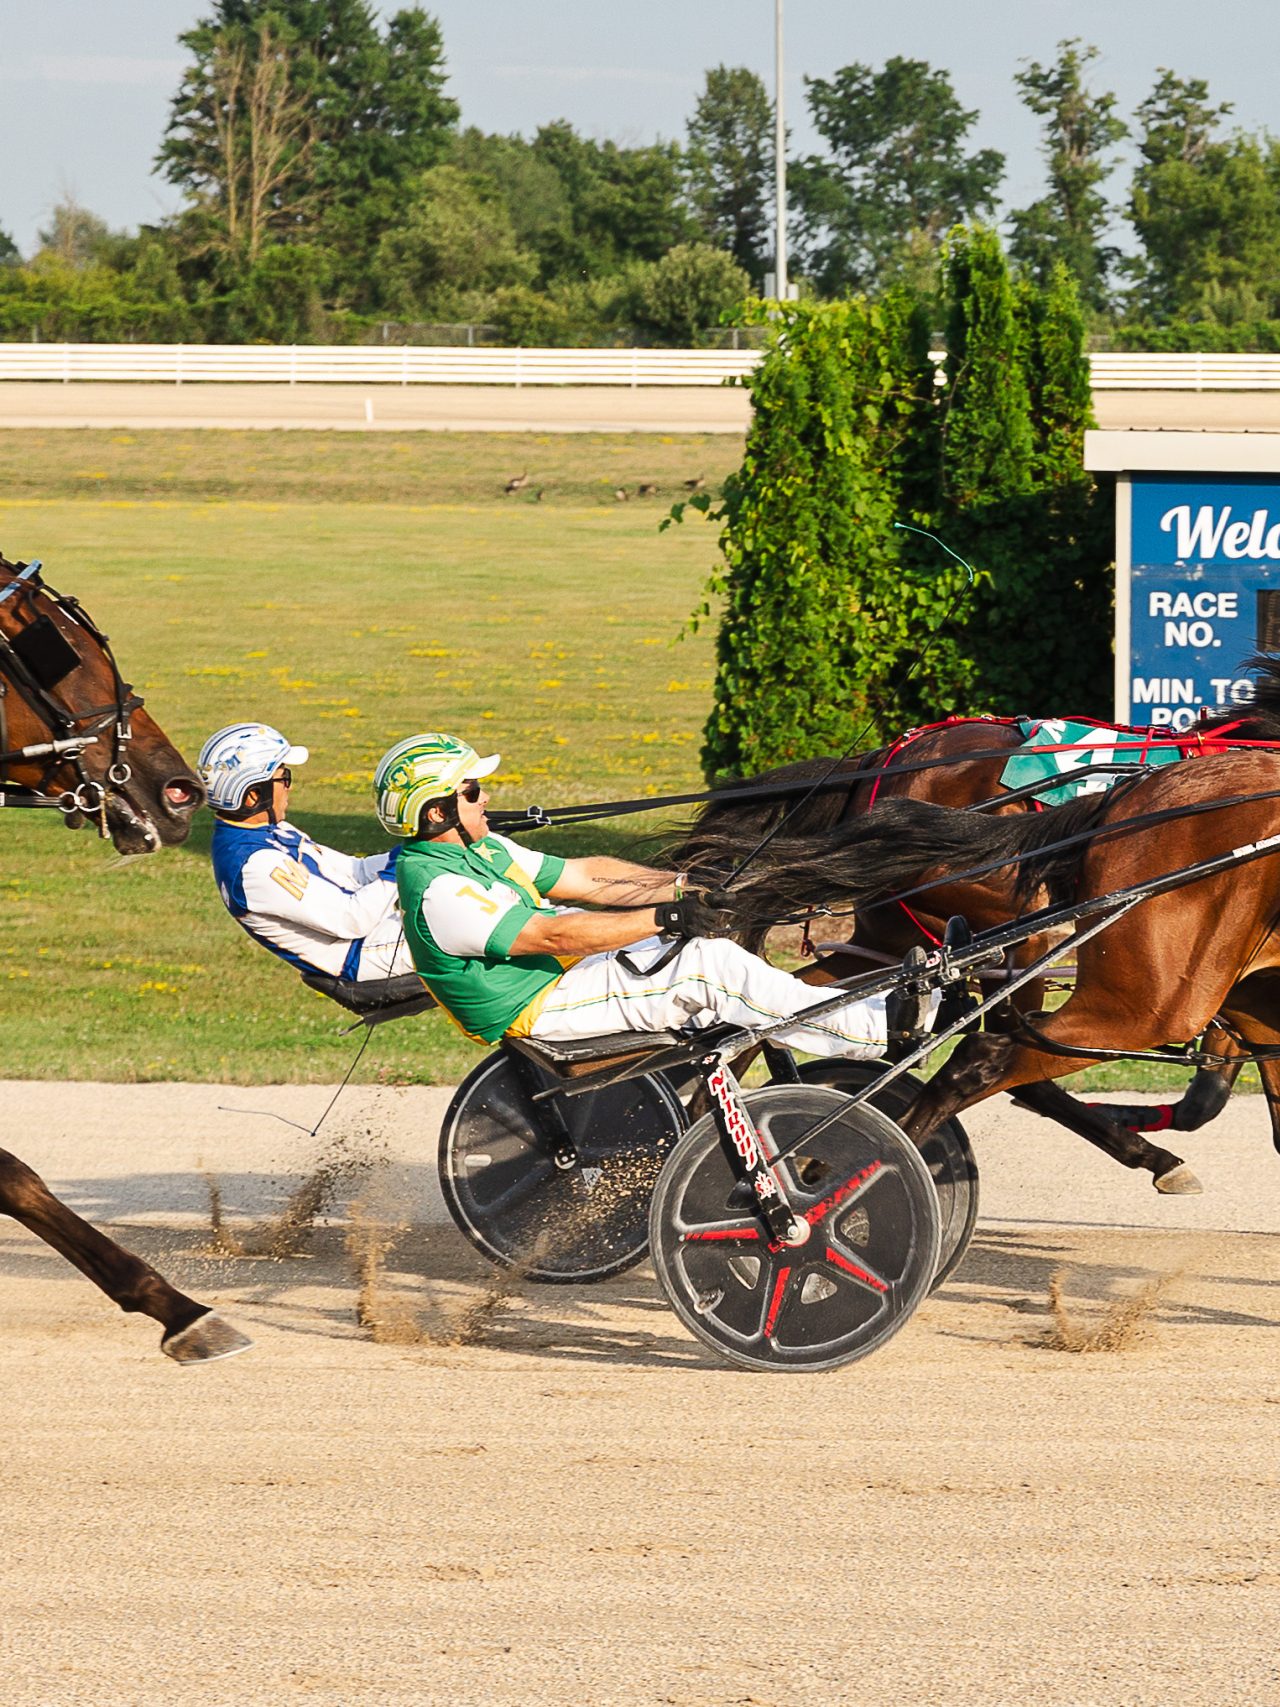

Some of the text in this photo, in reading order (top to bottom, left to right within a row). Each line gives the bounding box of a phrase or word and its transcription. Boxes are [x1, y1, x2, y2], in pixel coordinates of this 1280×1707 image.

[1149, 591, 1238, 618] RACE
[1165, 621, 1221, 648] NO.
[1132, 677, 1257, 704] MIN. TO
[455, 884, 499, 916] J
